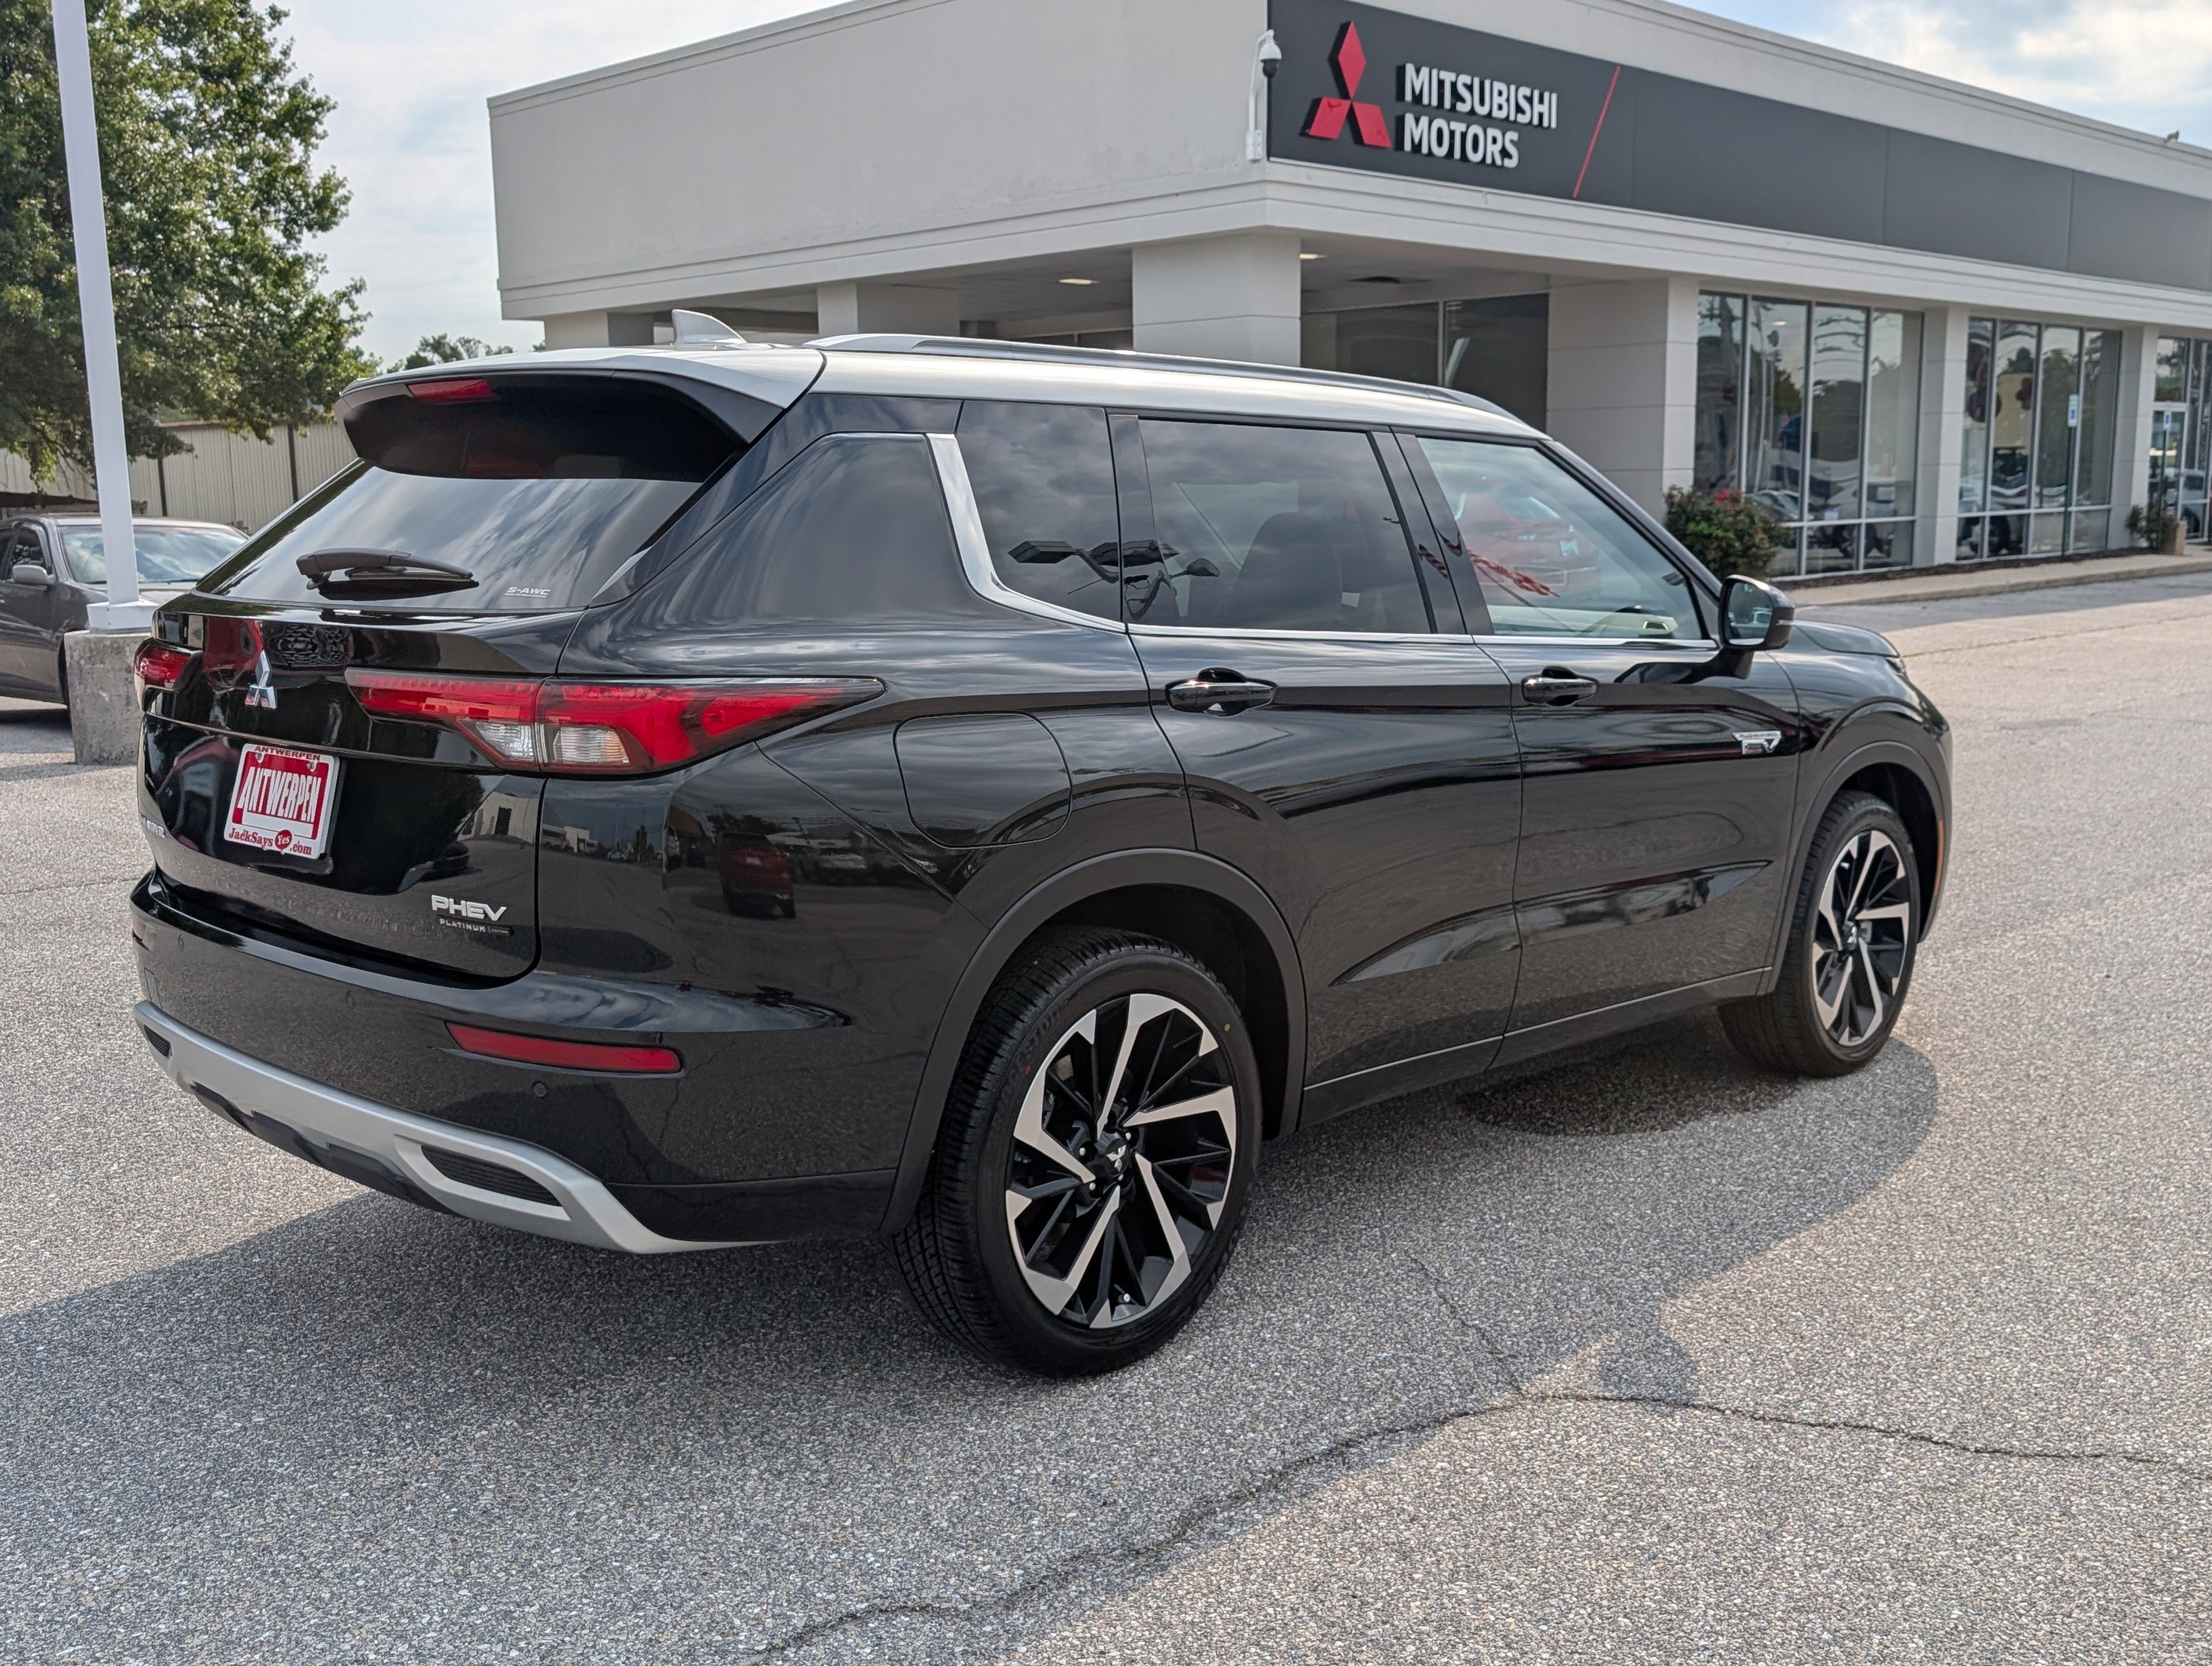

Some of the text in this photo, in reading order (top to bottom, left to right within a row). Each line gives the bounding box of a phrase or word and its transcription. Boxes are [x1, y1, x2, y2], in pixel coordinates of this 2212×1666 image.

[1405, 63, 1558, 129] MITSUBISHI
[1404, 113, 1519, 169] MOTORS
[507, 587, 551, 595] S-AWC
[255, 746, 320, 760] ANTWERPEN
[237, 766, 321, 823] ANTWERPEN
[431, 895, 507, 921] PHEV
[440, 918, 486, 933] PLATINUM
